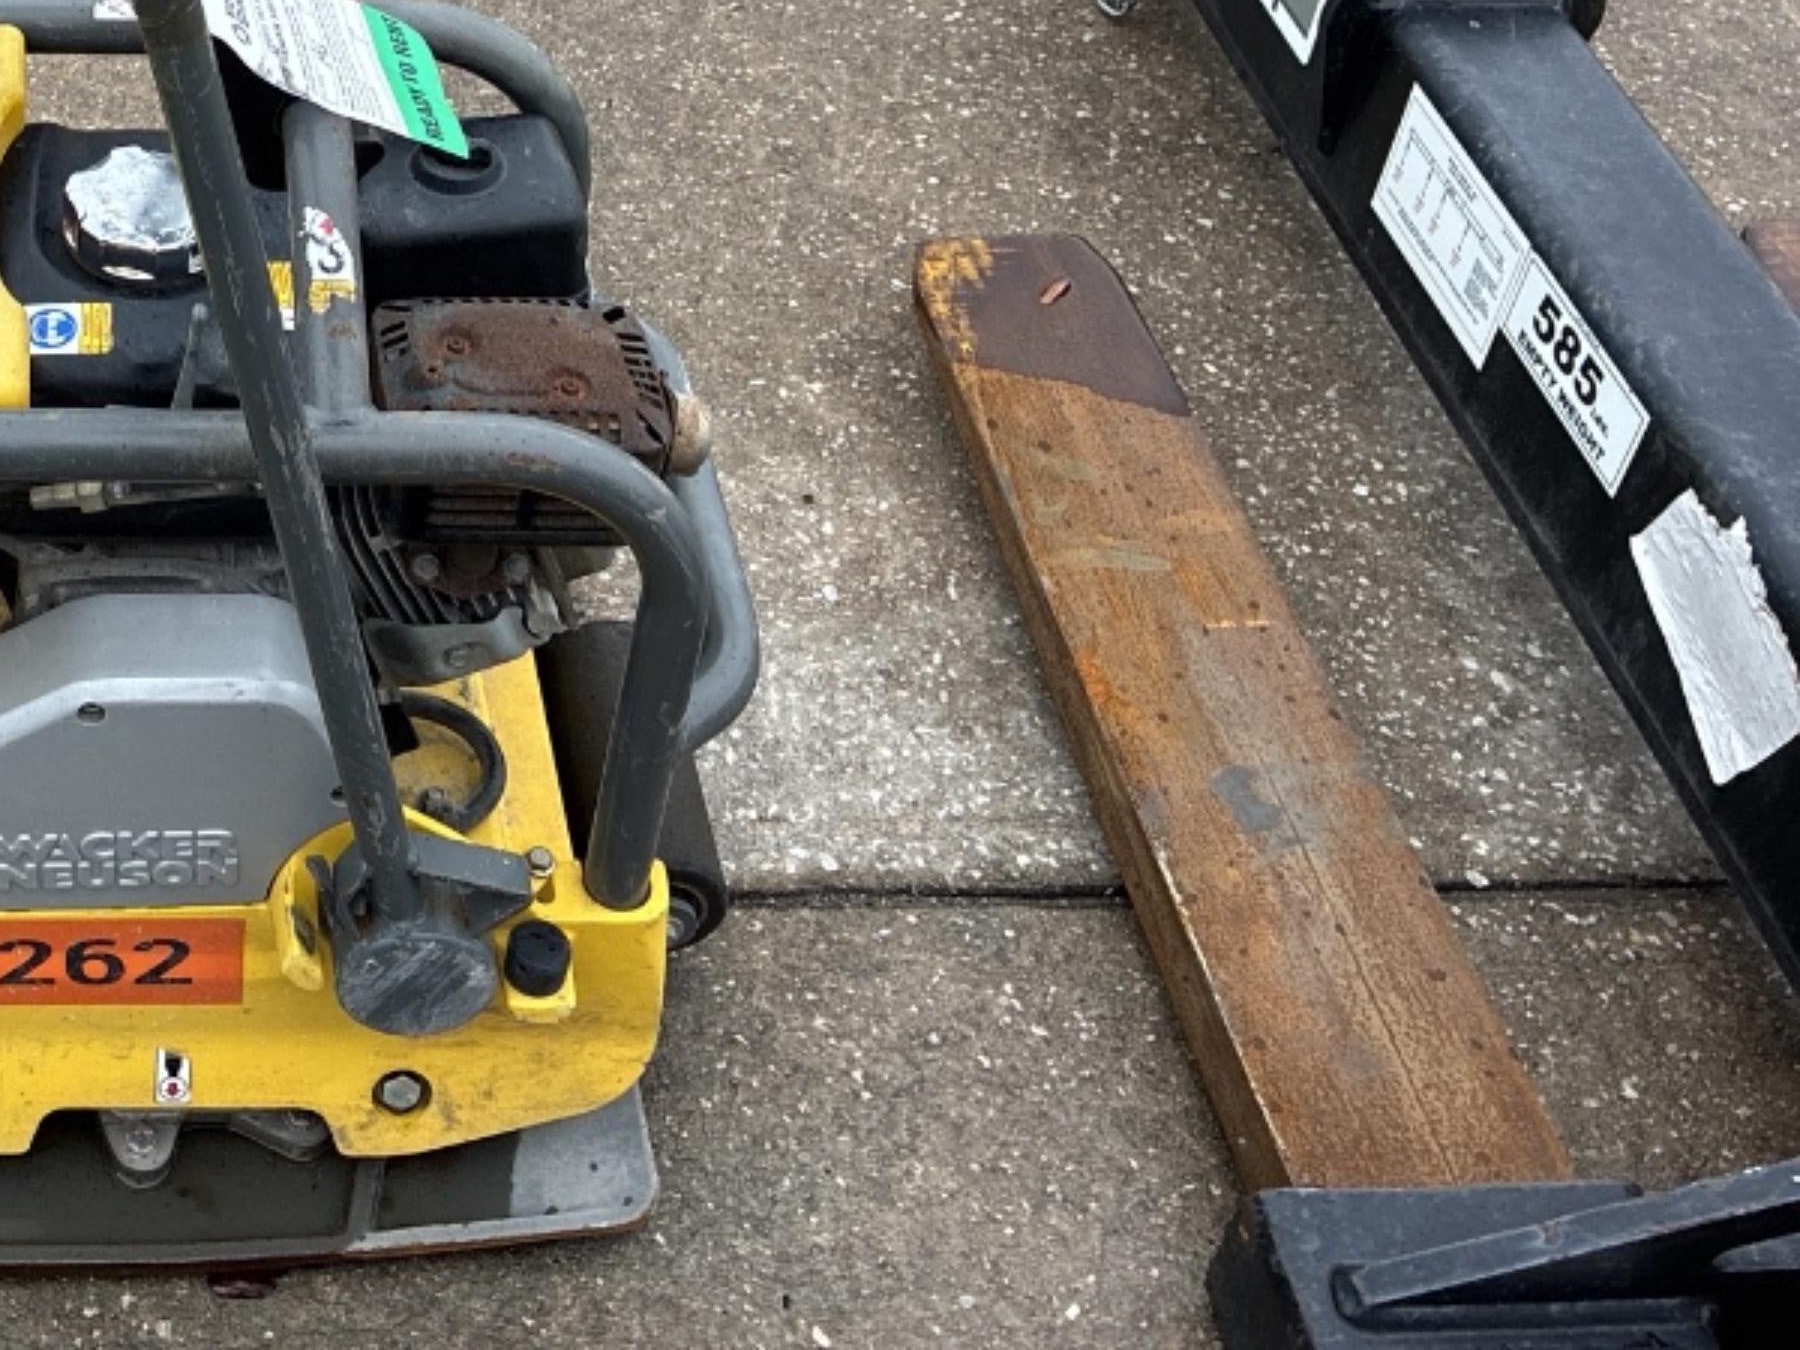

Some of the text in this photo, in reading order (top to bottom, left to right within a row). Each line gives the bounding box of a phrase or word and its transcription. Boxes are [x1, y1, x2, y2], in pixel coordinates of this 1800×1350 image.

[399, 61, 420, 85] TO
[406, 84, 445, 141] READY
[1533, 293, 1604, 406] 585
[1517, 327, 1606, 460] EMPTY WEIGHT
